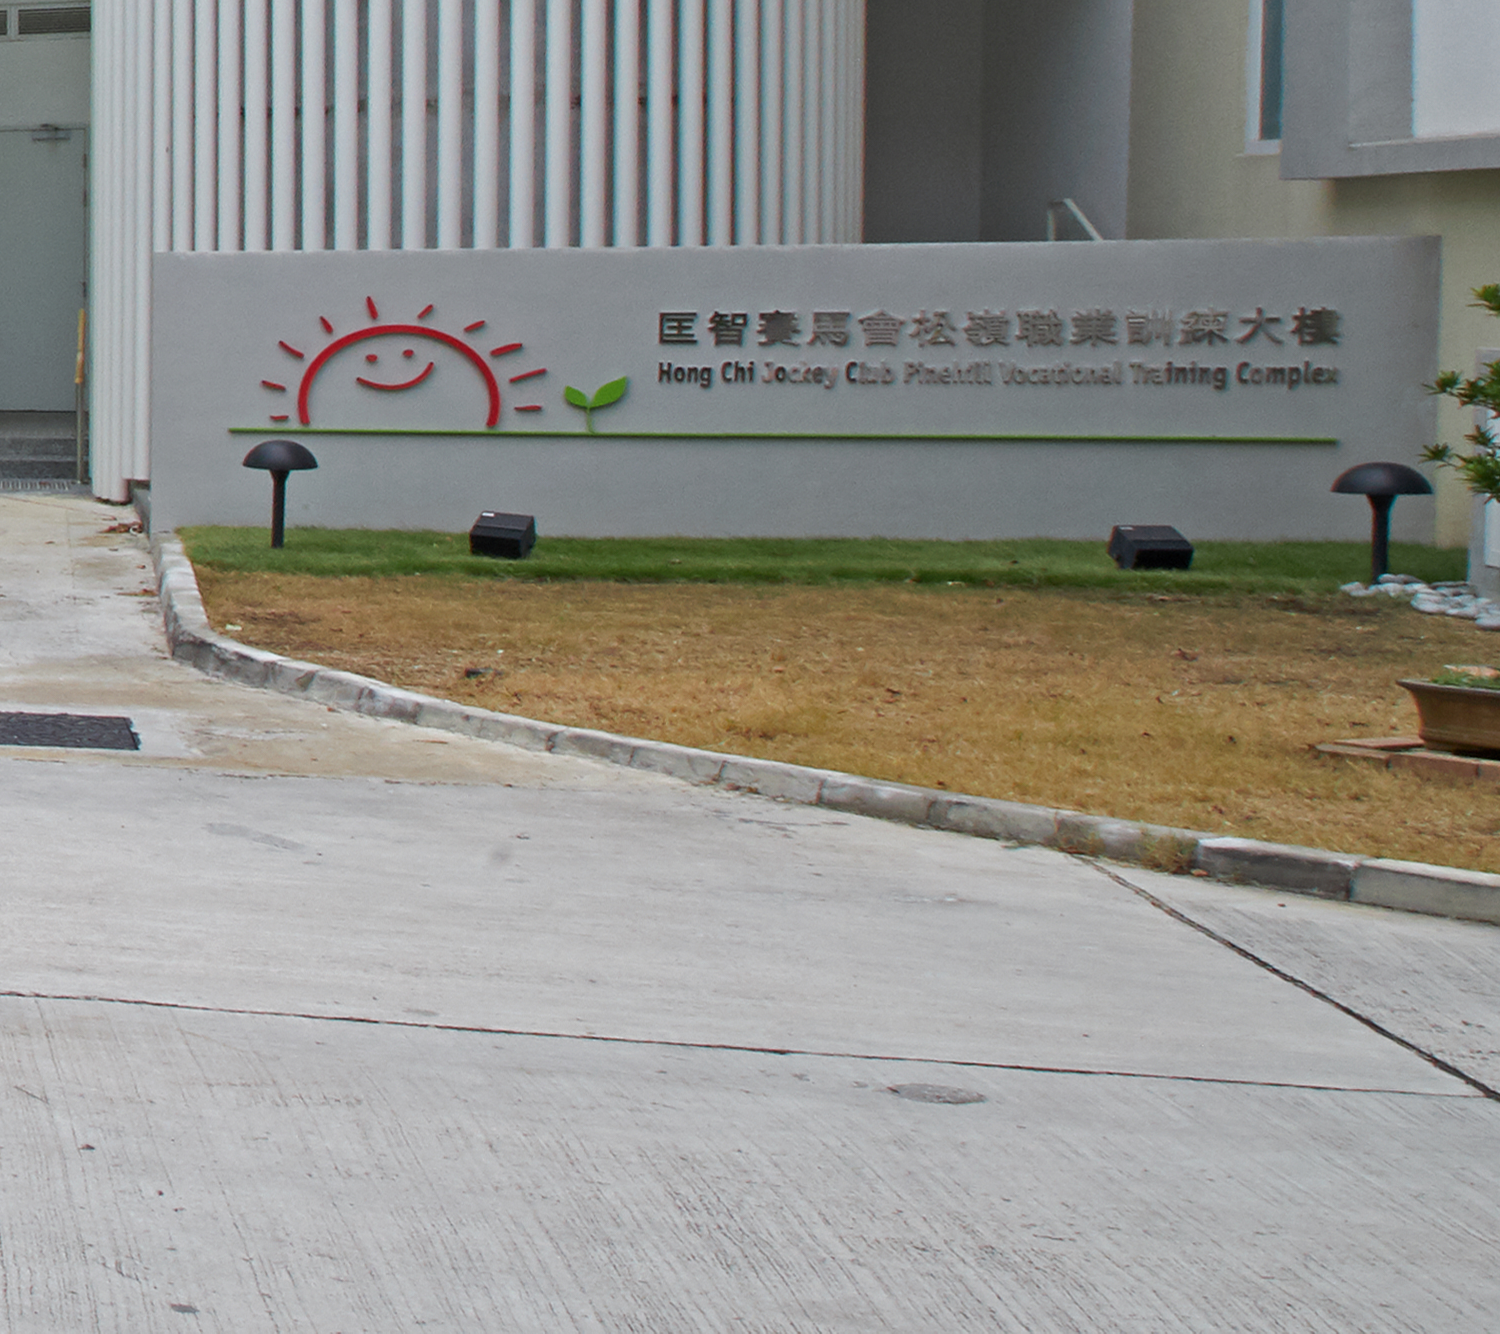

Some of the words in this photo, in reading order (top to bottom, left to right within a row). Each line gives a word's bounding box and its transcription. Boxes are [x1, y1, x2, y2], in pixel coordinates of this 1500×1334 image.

[658, 361, 711, 389] Hong
[720, 361, 754, 383] Chi
[762, 361, 839, 390] Jockey
[845, 361, 895, 384] Club
[903, 361, 992, 385] Pinehill
[999, 361, 1122, 385] Vocational
[1129, 361, 1228, 390] Training
[1236, 361, 1340, 390] Complex
